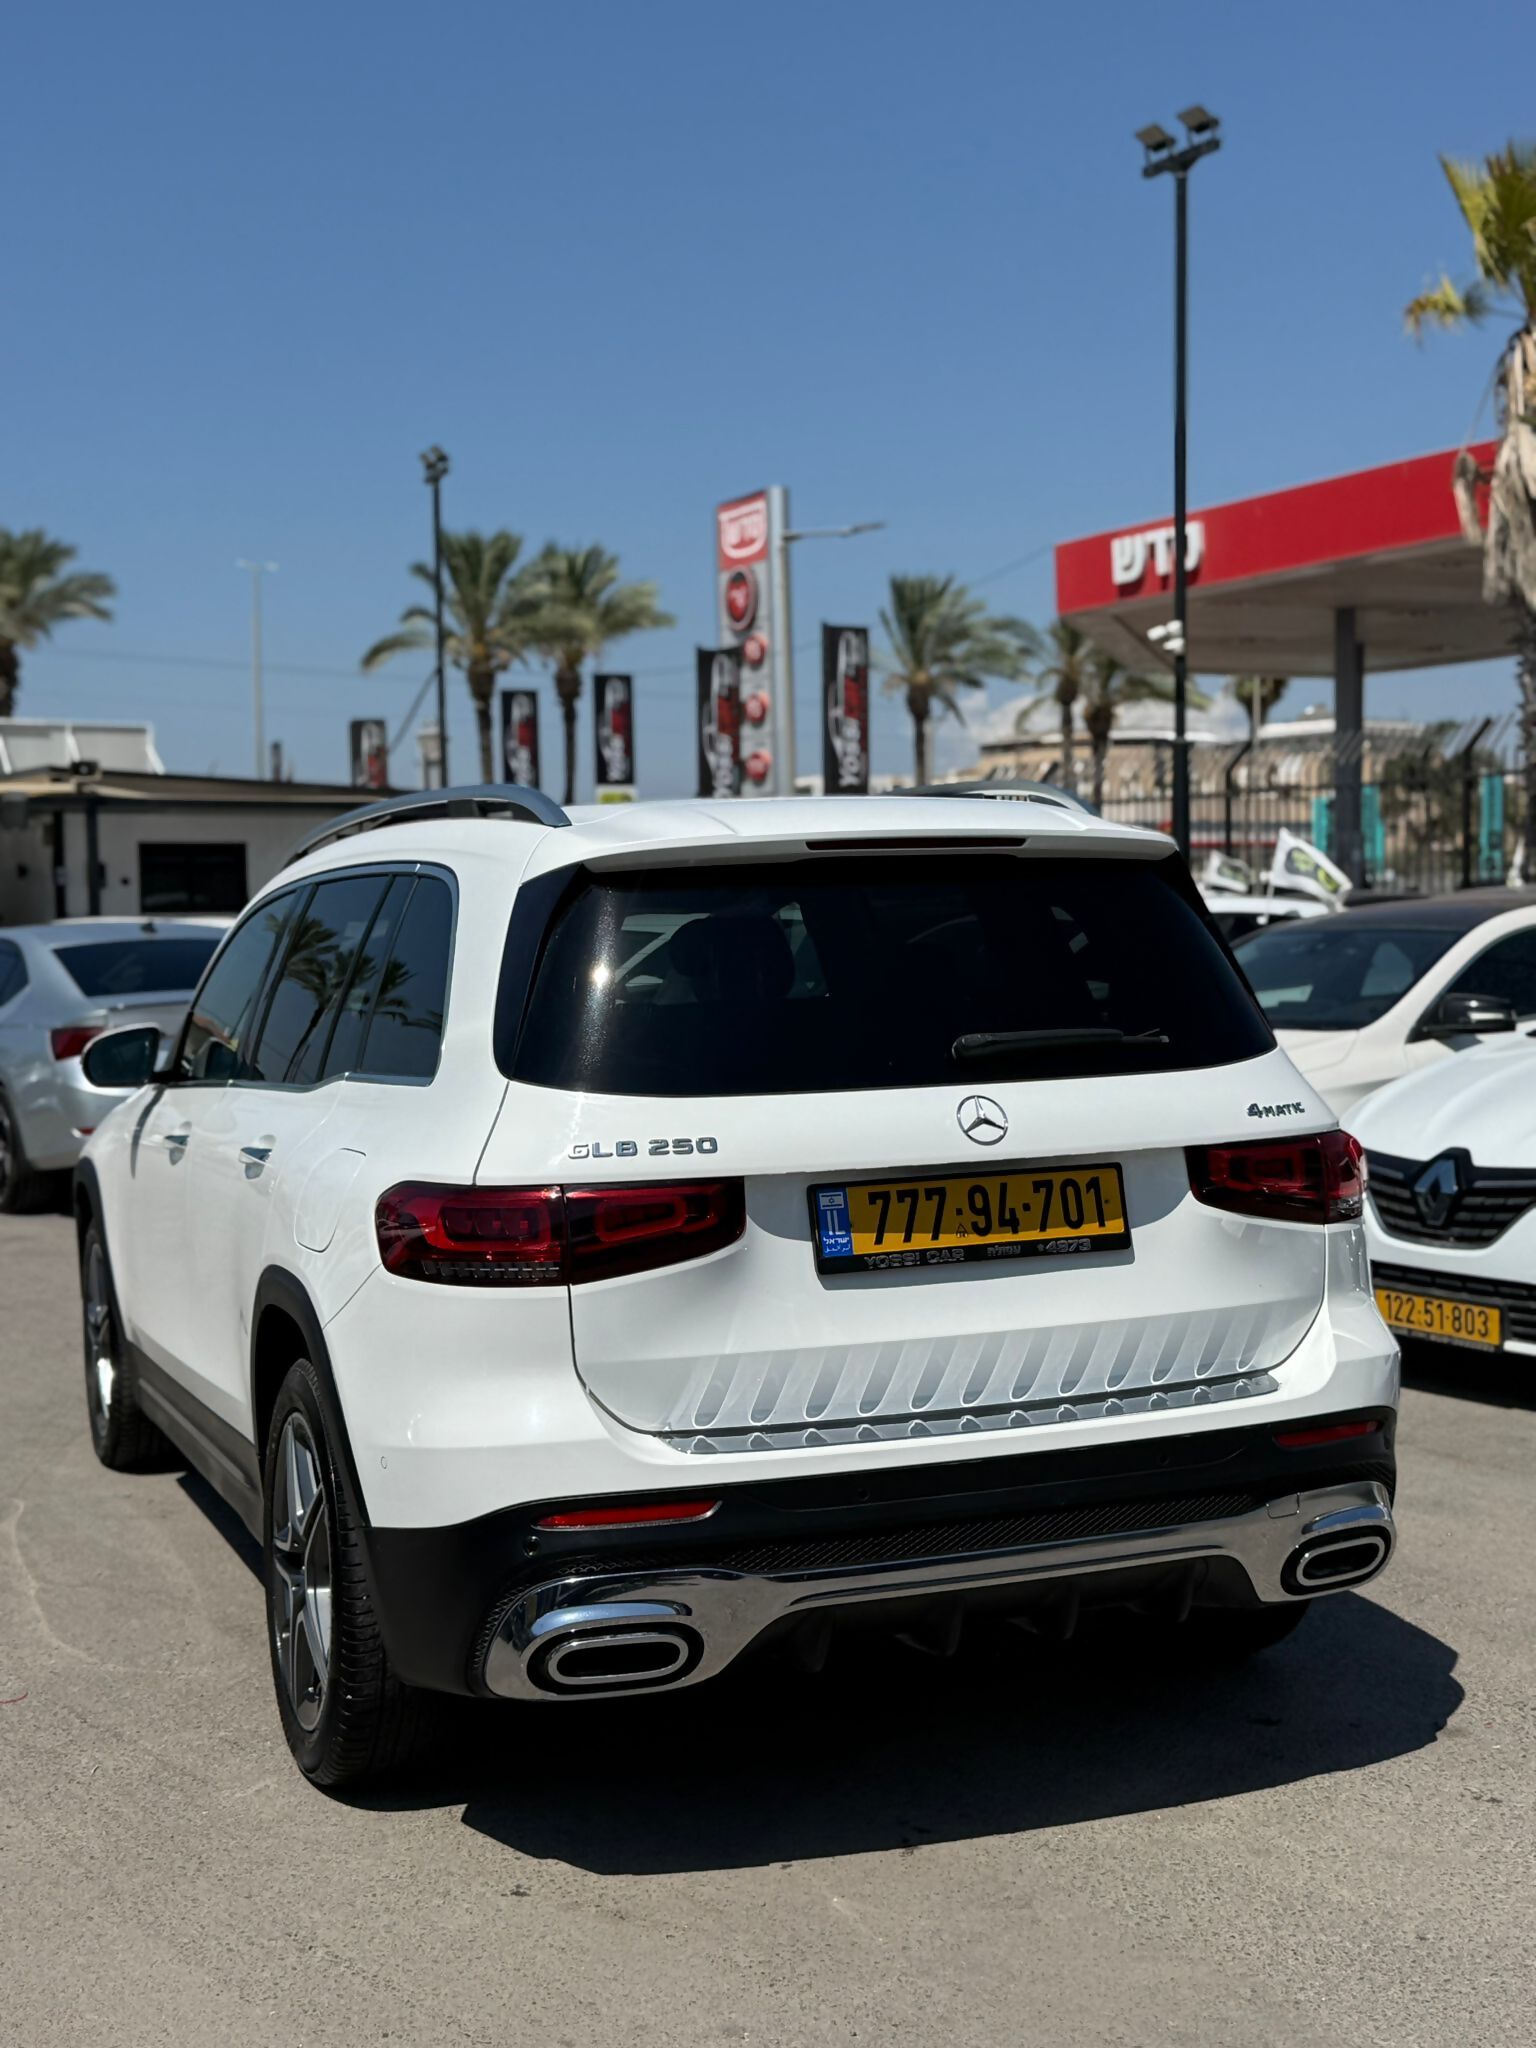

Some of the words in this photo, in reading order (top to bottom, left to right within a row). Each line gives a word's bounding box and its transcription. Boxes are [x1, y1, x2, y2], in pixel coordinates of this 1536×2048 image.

[1247, 1101, 1305, 1118] 4MATIC
[568, 1140, 638, 1159] GLB
[648, 1137, 718, 1156] 250
[827, 1210, 846, 1235] IL
[926, 1249, 964, 1264] CAR
